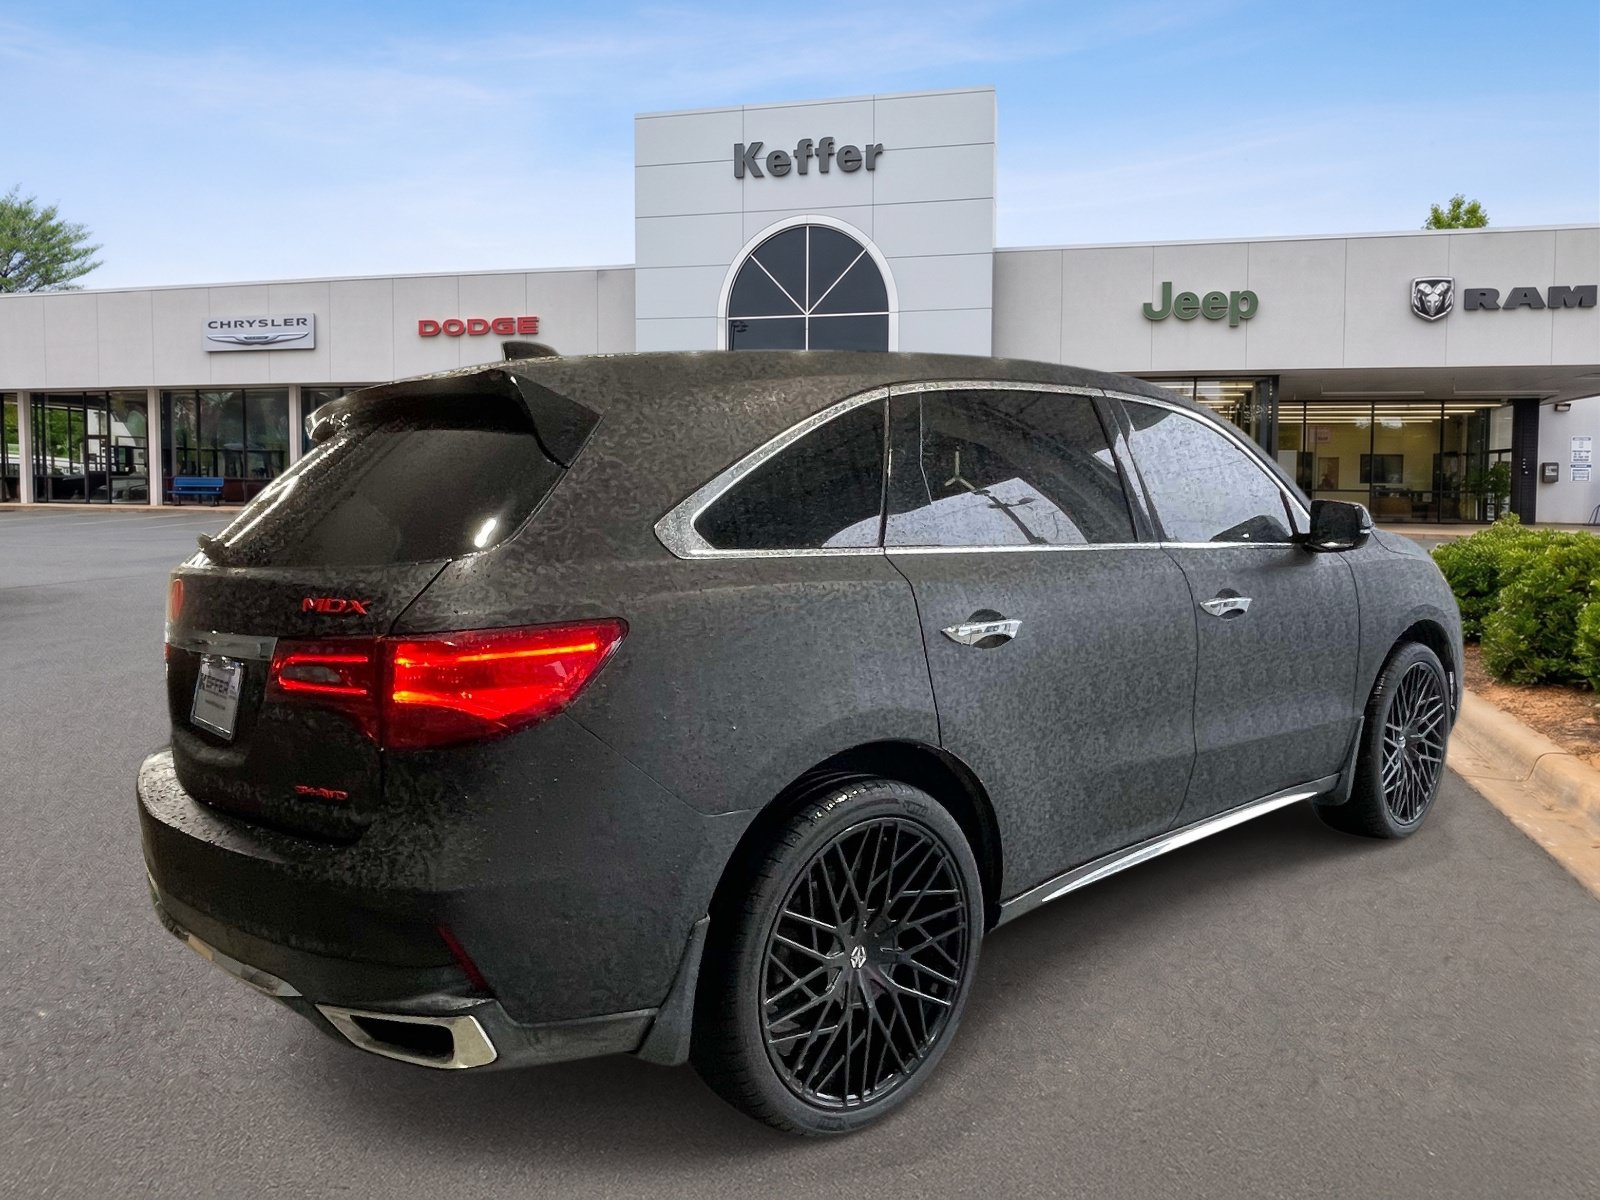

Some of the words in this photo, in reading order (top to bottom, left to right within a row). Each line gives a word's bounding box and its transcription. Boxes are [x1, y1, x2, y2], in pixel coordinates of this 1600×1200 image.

[733, 136, 884, 179] Keffer
[1143, 281, 1259, 327] Jeep
[1464, 284, 1598, 311] RAM
[207, 317, 308, 329] CHRYSLER
[418, 316, 539, 337] DODGE
[302, 597, 373, 616] MDX
